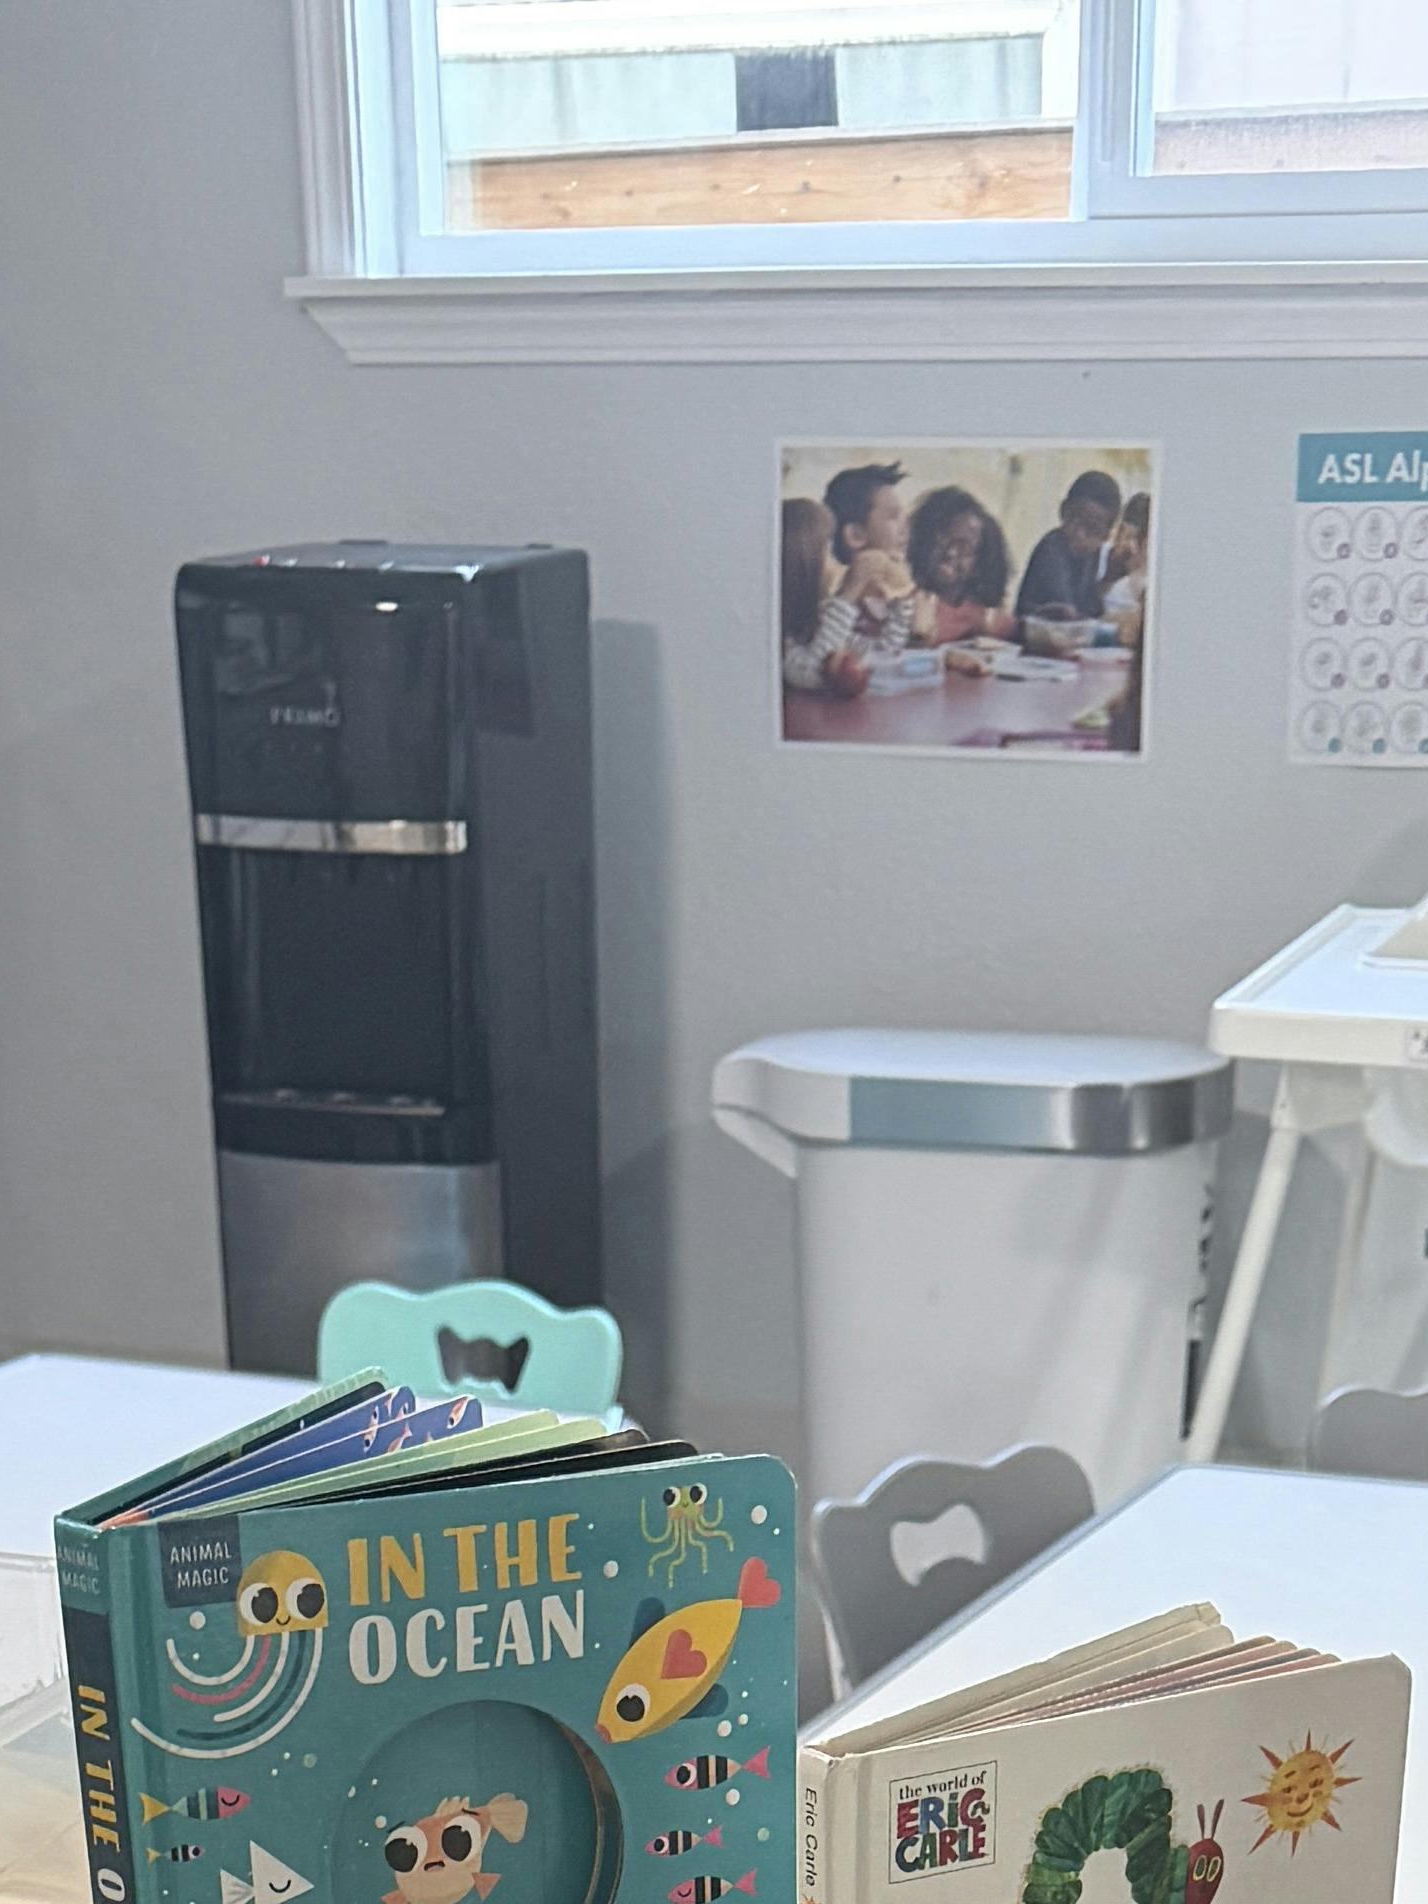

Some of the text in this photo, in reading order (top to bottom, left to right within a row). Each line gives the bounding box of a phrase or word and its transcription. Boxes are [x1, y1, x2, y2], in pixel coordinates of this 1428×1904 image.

[1318, 451, 1379, 486] ASL
[57, 1545, 100, 1571] ANIMAL
[171, 1540, 233, 1564] ANIMAL
[347, 1513, 583, 1607] IN THE
[61, 1571, 101, 1595] MAGIC
[176, 1567, 230, 1590] MAGIC
[348, 1590, 585, 1685] OCEAN
[77, 1684, 110, 1741] IN
[84, 1759, 121, 1853] THE
[899, 1770, 987, 1800] the world of
[804, 1786, 819, 1887] Eric Carle
[895, 1823, 987, 1873] CARLE
